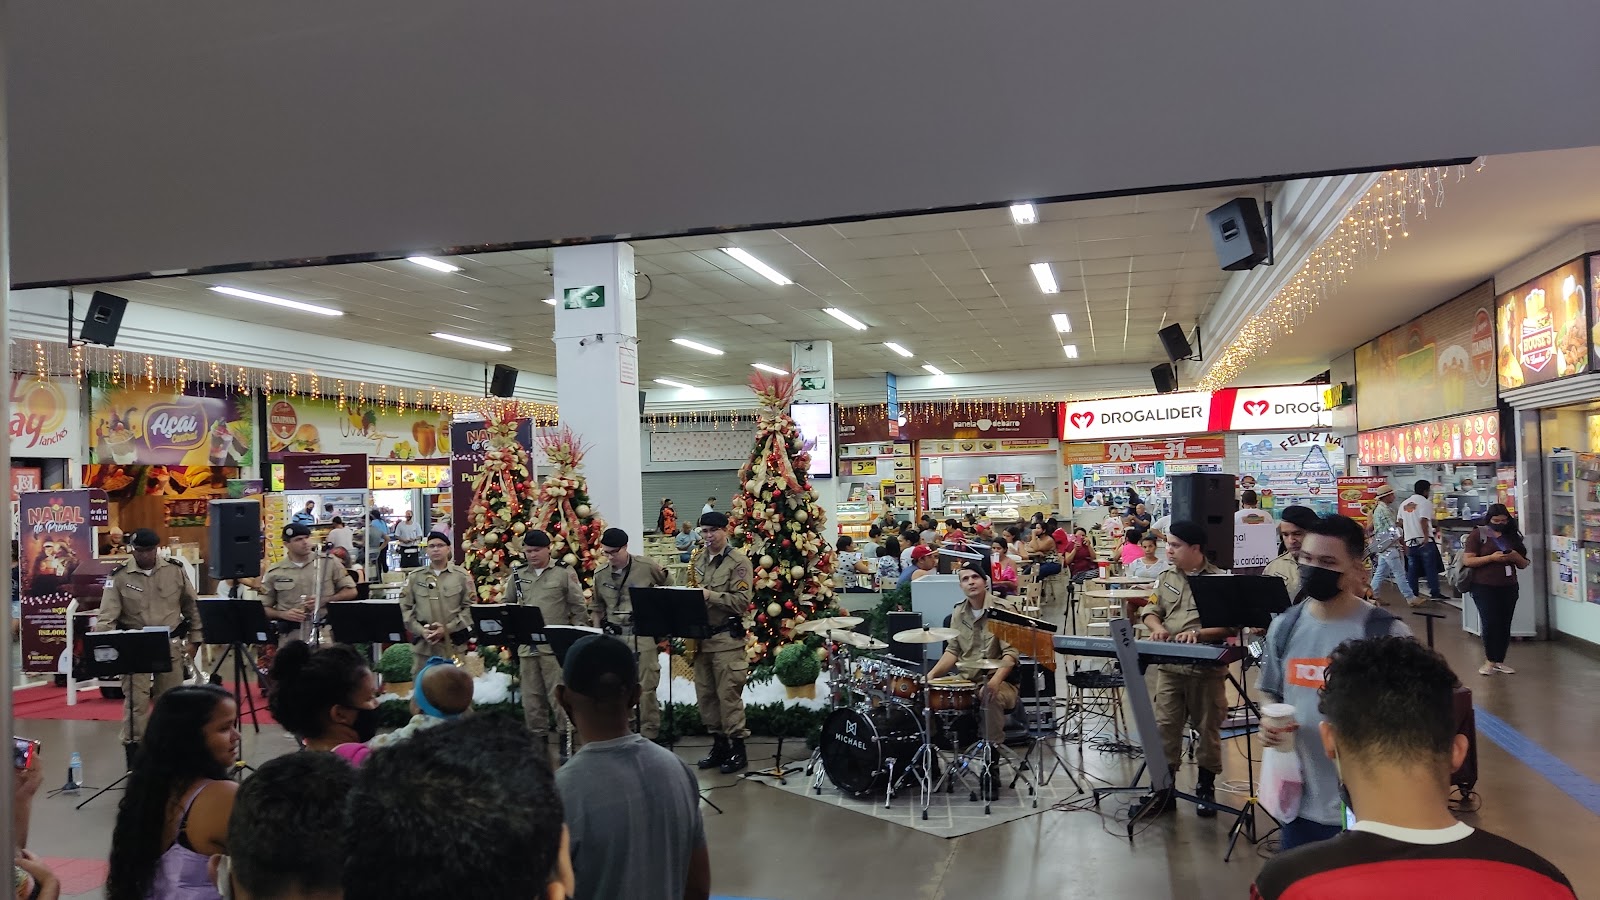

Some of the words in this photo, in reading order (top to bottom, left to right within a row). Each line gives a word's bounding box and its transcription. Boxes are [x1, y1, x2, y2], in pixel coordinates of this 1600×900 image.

[1101, 406, 1203, 424] DROGALIDER
[1275, 402, 1321, 415] DROG
[9, 413, 47, 448] ay
[953, 420, 977, 429] panela
[39, 427, 68, 446] lanches
[1280, 432, 1319, 451] FELIZ
[1325, 433, 1344, 448] NA
[473, 463, 485, 472] Lo
[461, 473, 477, 482] Par
[28, 506, 84, 526] NATAL
[33, 520, 43, 534] de
[835, 732, 867, 751] MICHAEL
